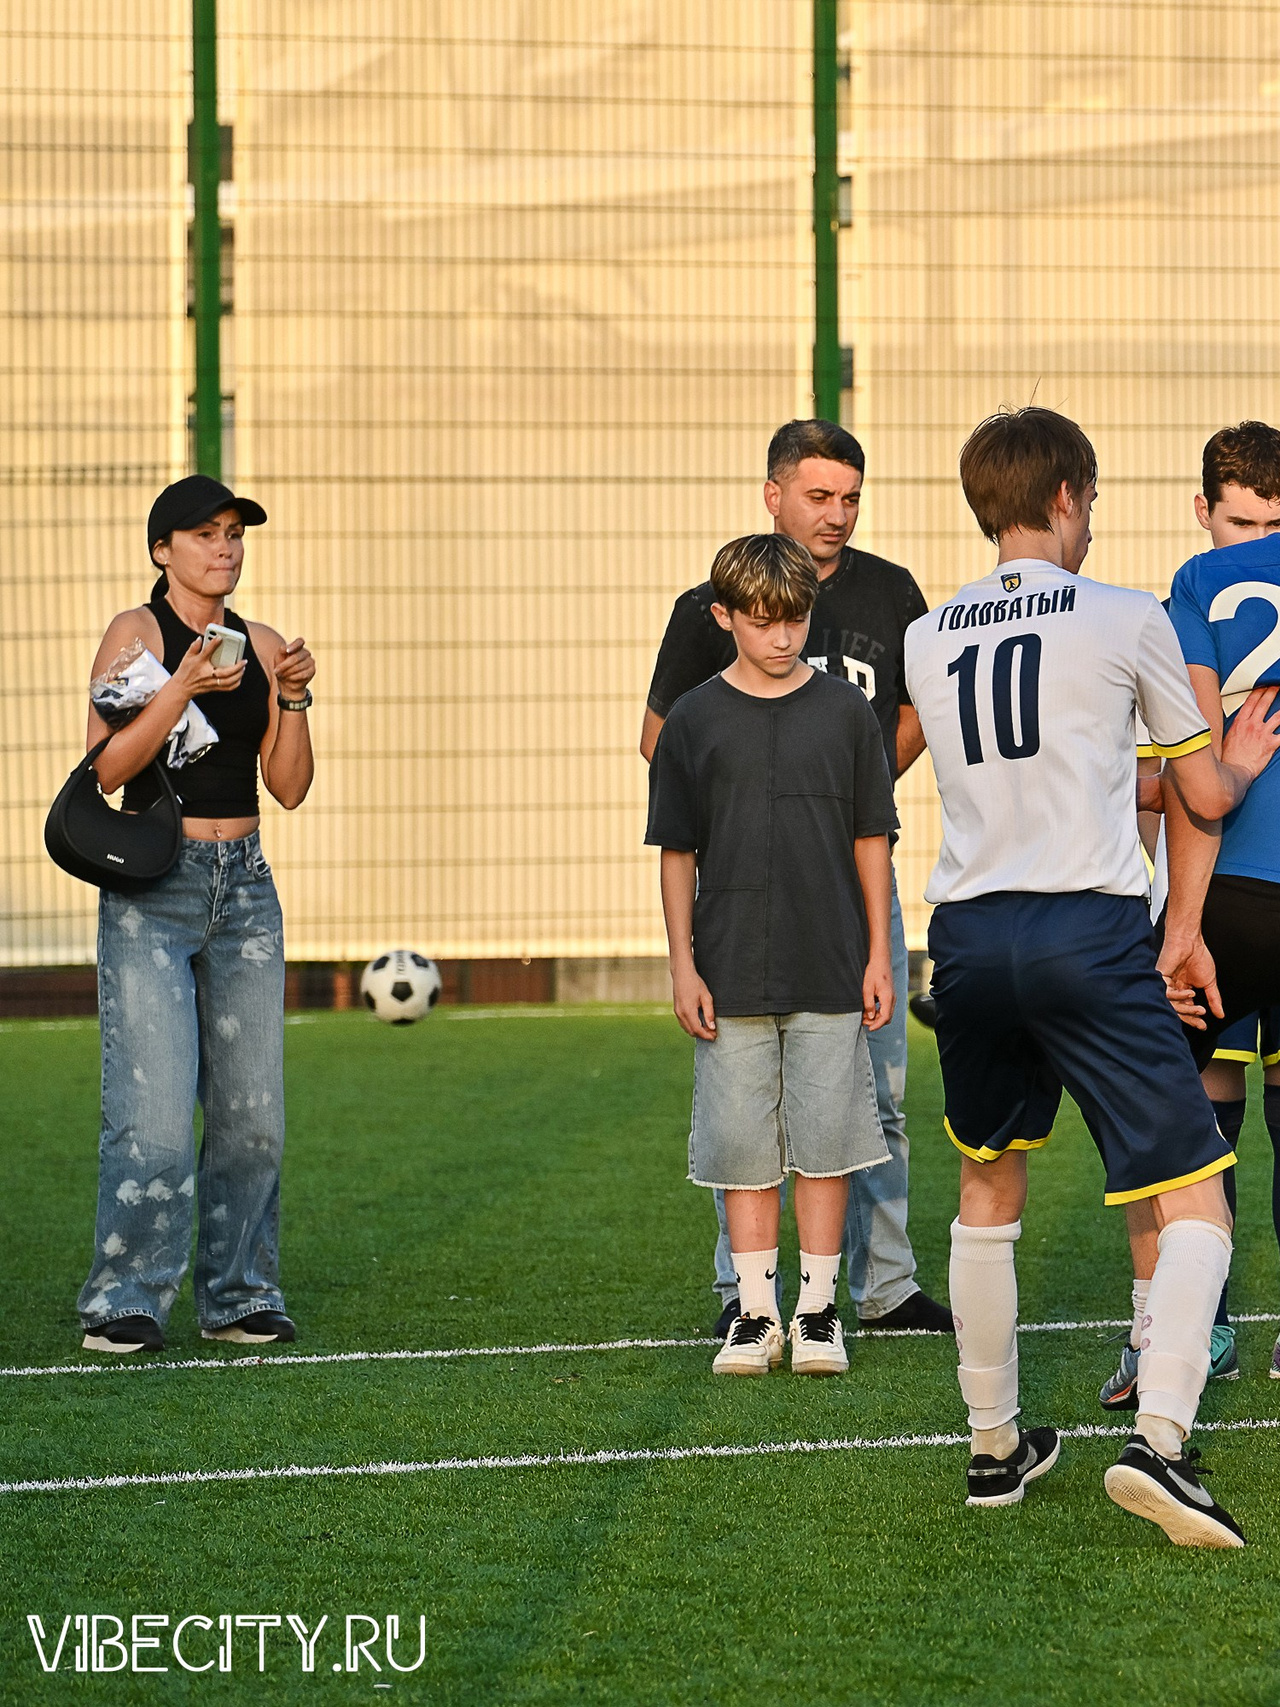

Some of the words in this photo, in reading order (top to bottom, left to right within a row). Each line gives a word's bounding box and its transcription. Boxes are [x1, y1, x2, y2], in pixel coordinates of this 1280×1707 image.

[938, 585, 1076, 632] ГОЛОВАТЫЙ
[947, 633, 1042, 766] 10
[107, 854, 125, 864] HUGO
